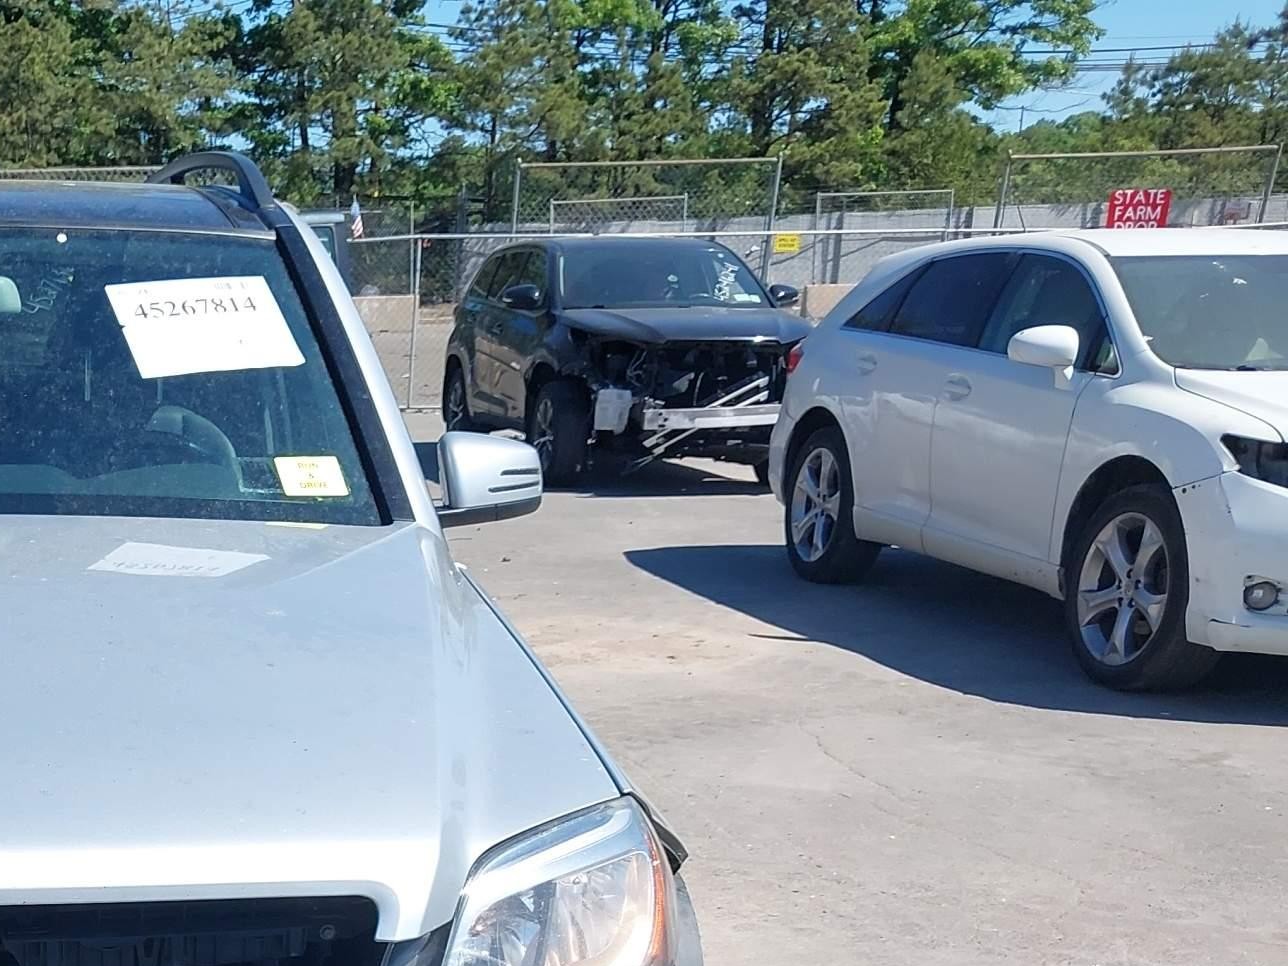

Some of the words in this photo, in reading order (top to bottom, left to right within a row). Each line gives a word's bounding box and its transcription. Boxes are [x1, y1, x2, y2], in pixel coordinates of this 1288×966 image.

[1114, 189, 1167, 205] STATE
[1113, 206, 1162, 221] FARM
[134, 296, 257, 319] 45267814
